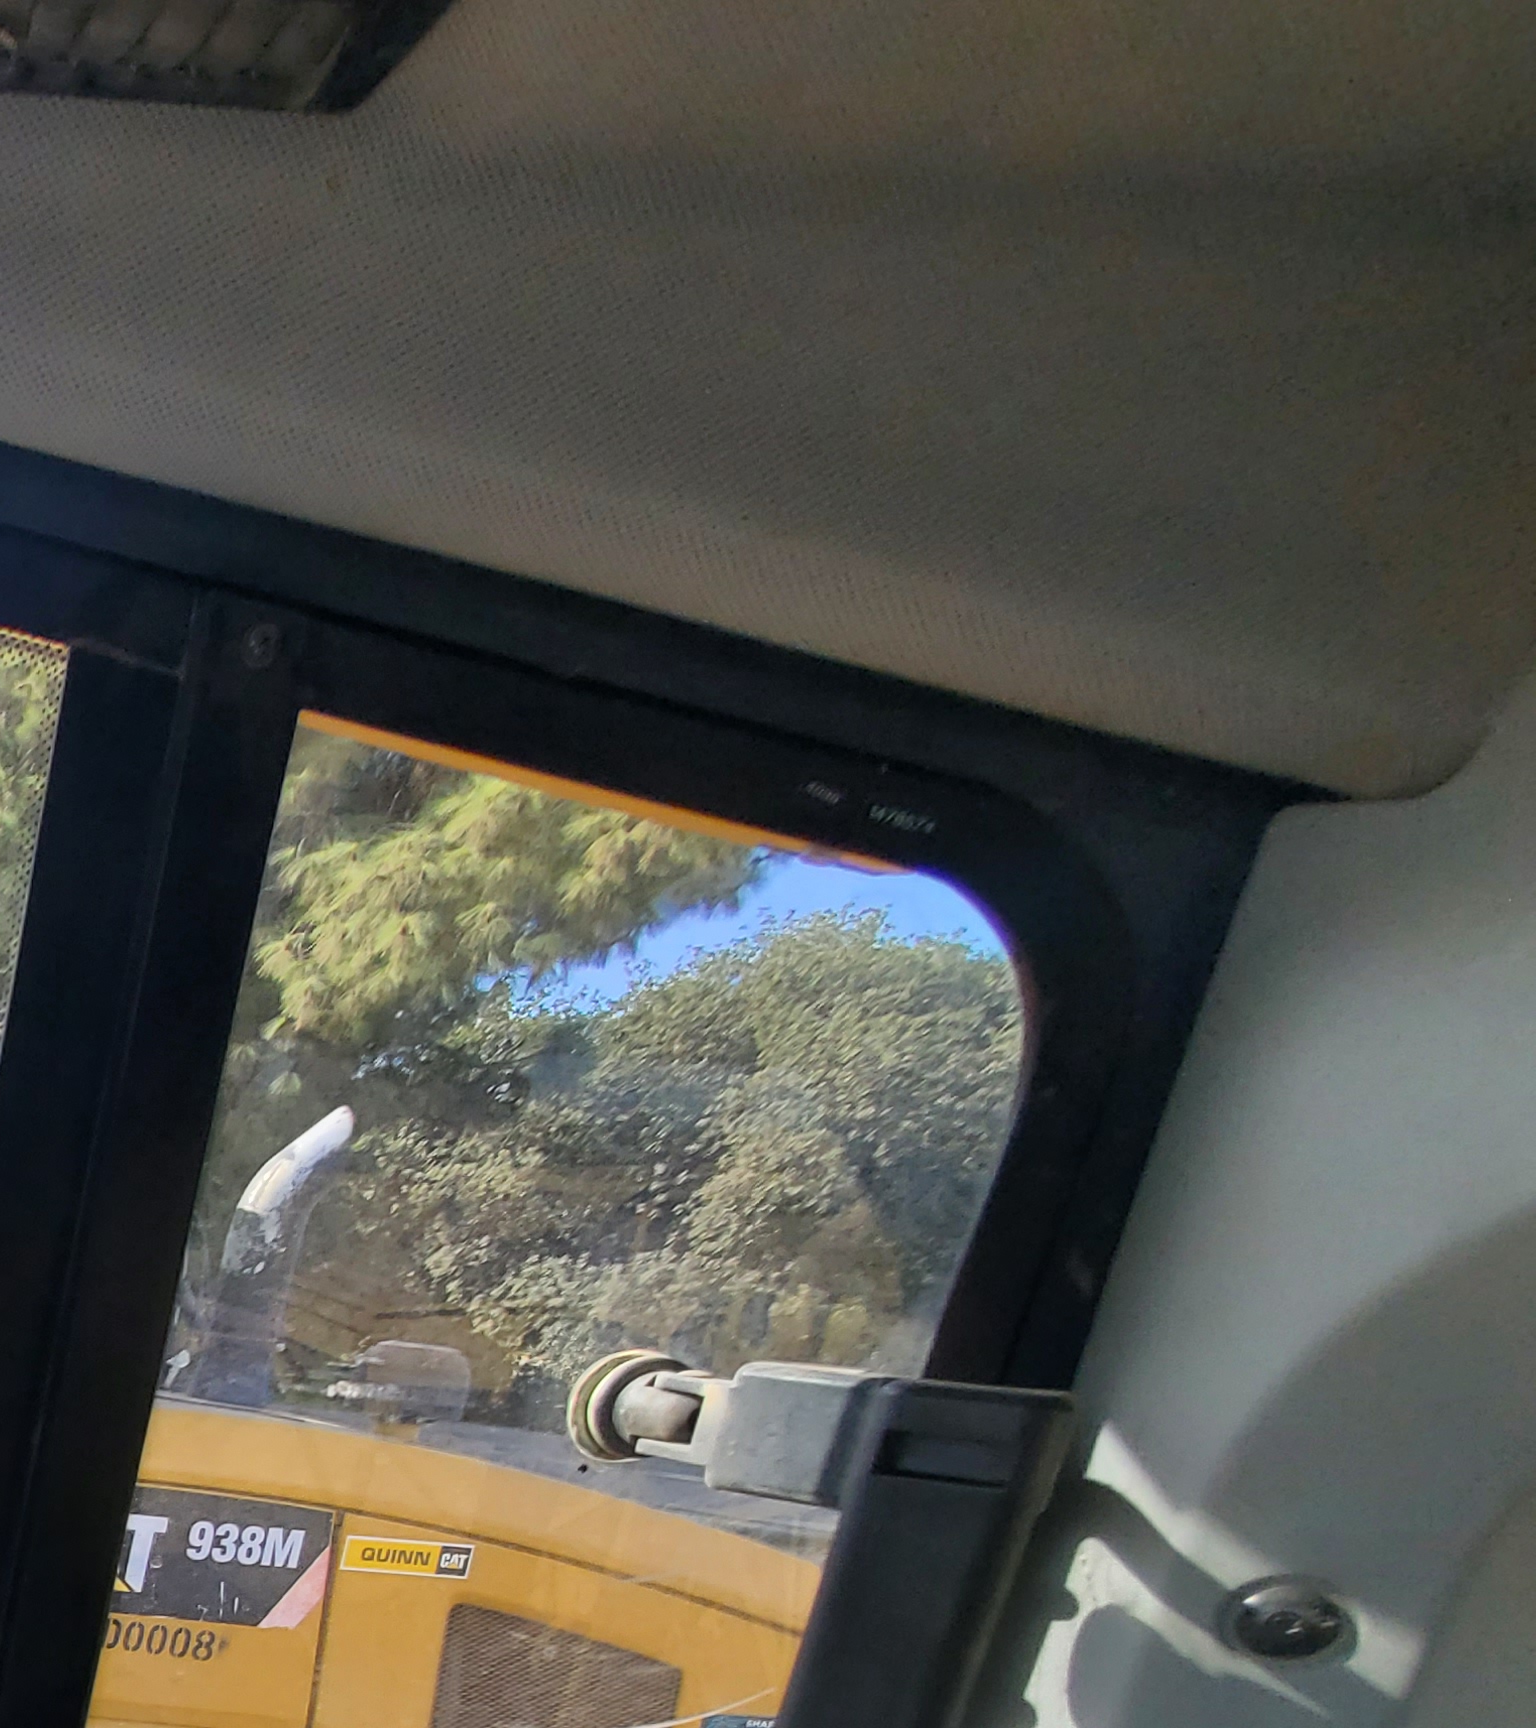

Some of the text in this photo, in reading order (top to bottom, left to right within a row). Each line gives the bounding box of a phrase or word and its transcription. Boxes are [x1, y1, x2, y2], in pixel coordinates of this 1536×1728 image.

[185, 1520, 307, 1570] 938M
[361, 1546, 469, 1571] QUINN CAT
